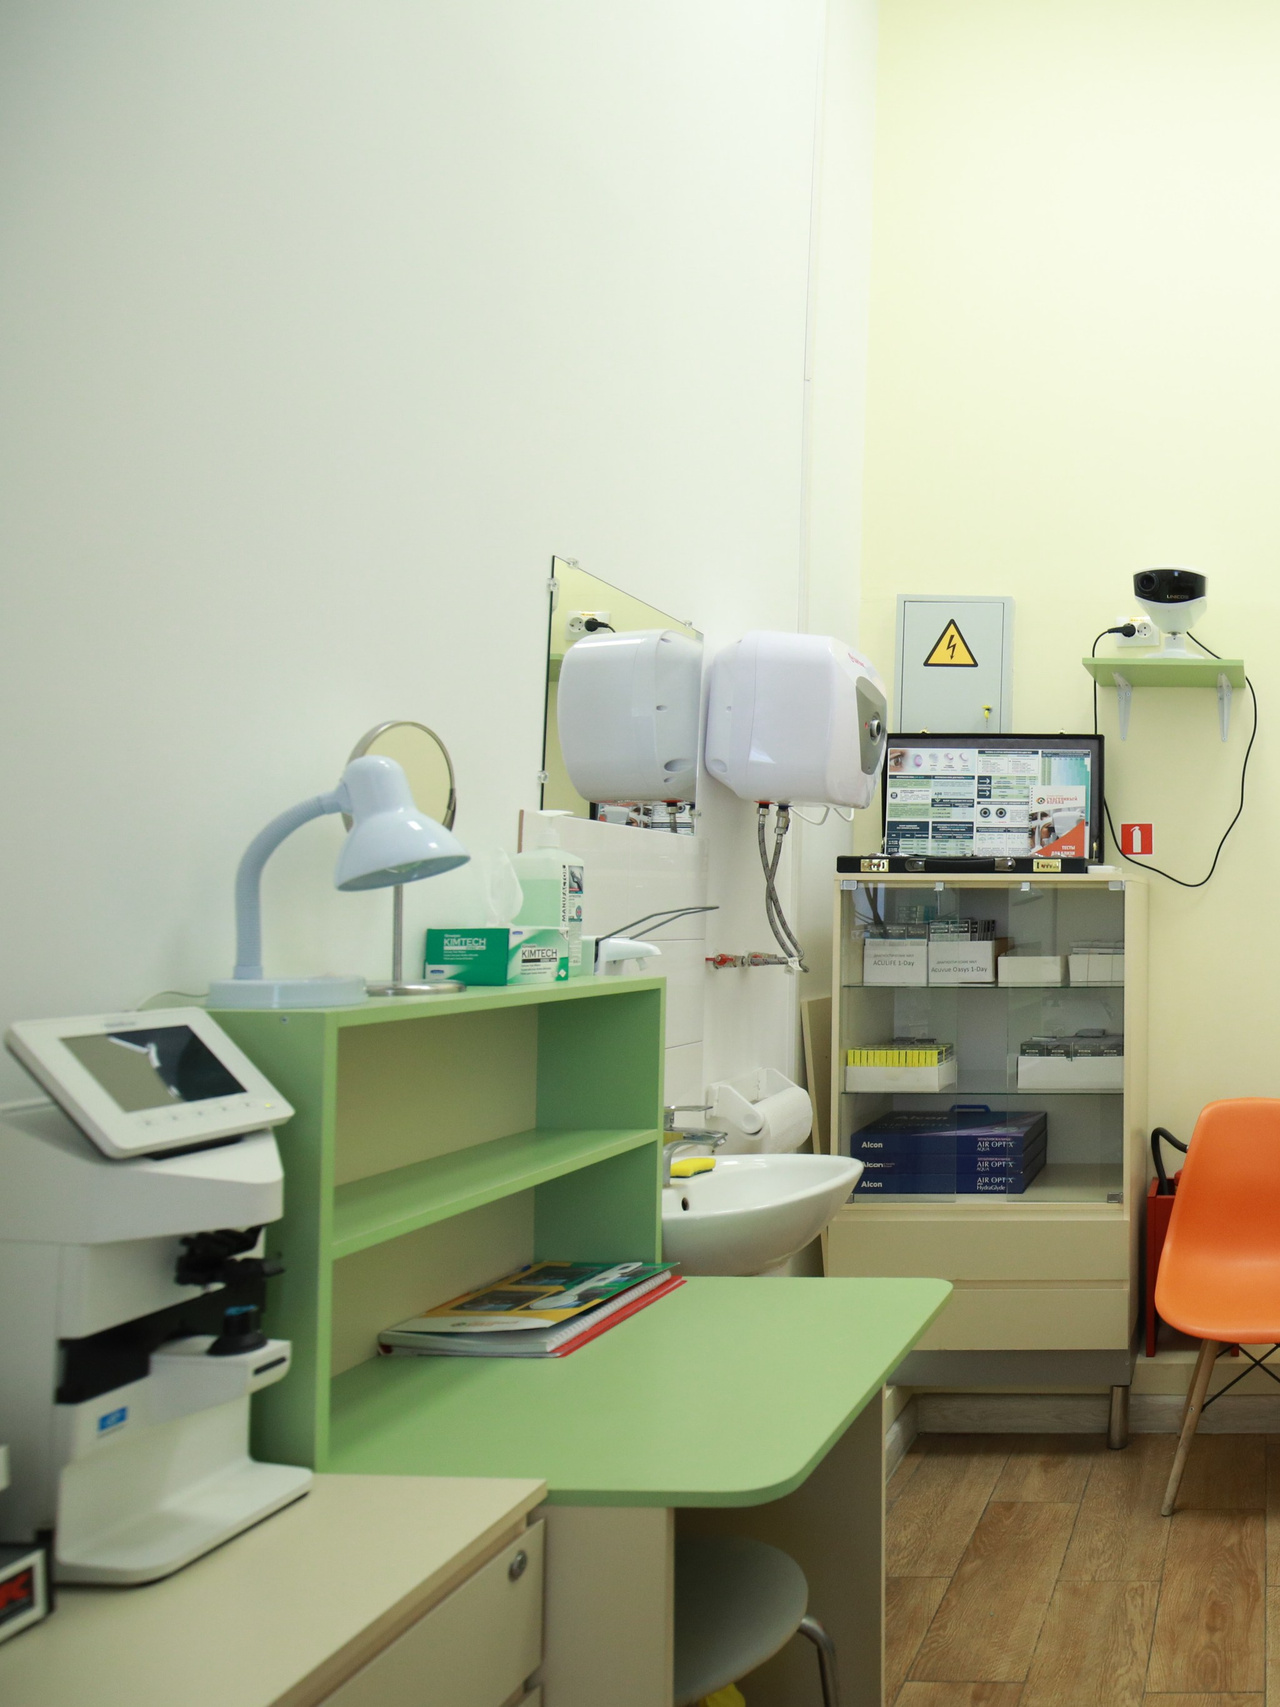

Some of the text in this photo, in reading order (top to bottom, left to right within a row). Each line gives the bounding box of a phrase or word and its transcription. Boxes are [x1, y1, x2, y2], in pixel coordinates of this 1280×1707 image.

[443, 938, 486, 946] KIMTECH
[521, 949, 557, 958] KIMTECH
[952, 966, 970, 974] Oasys
